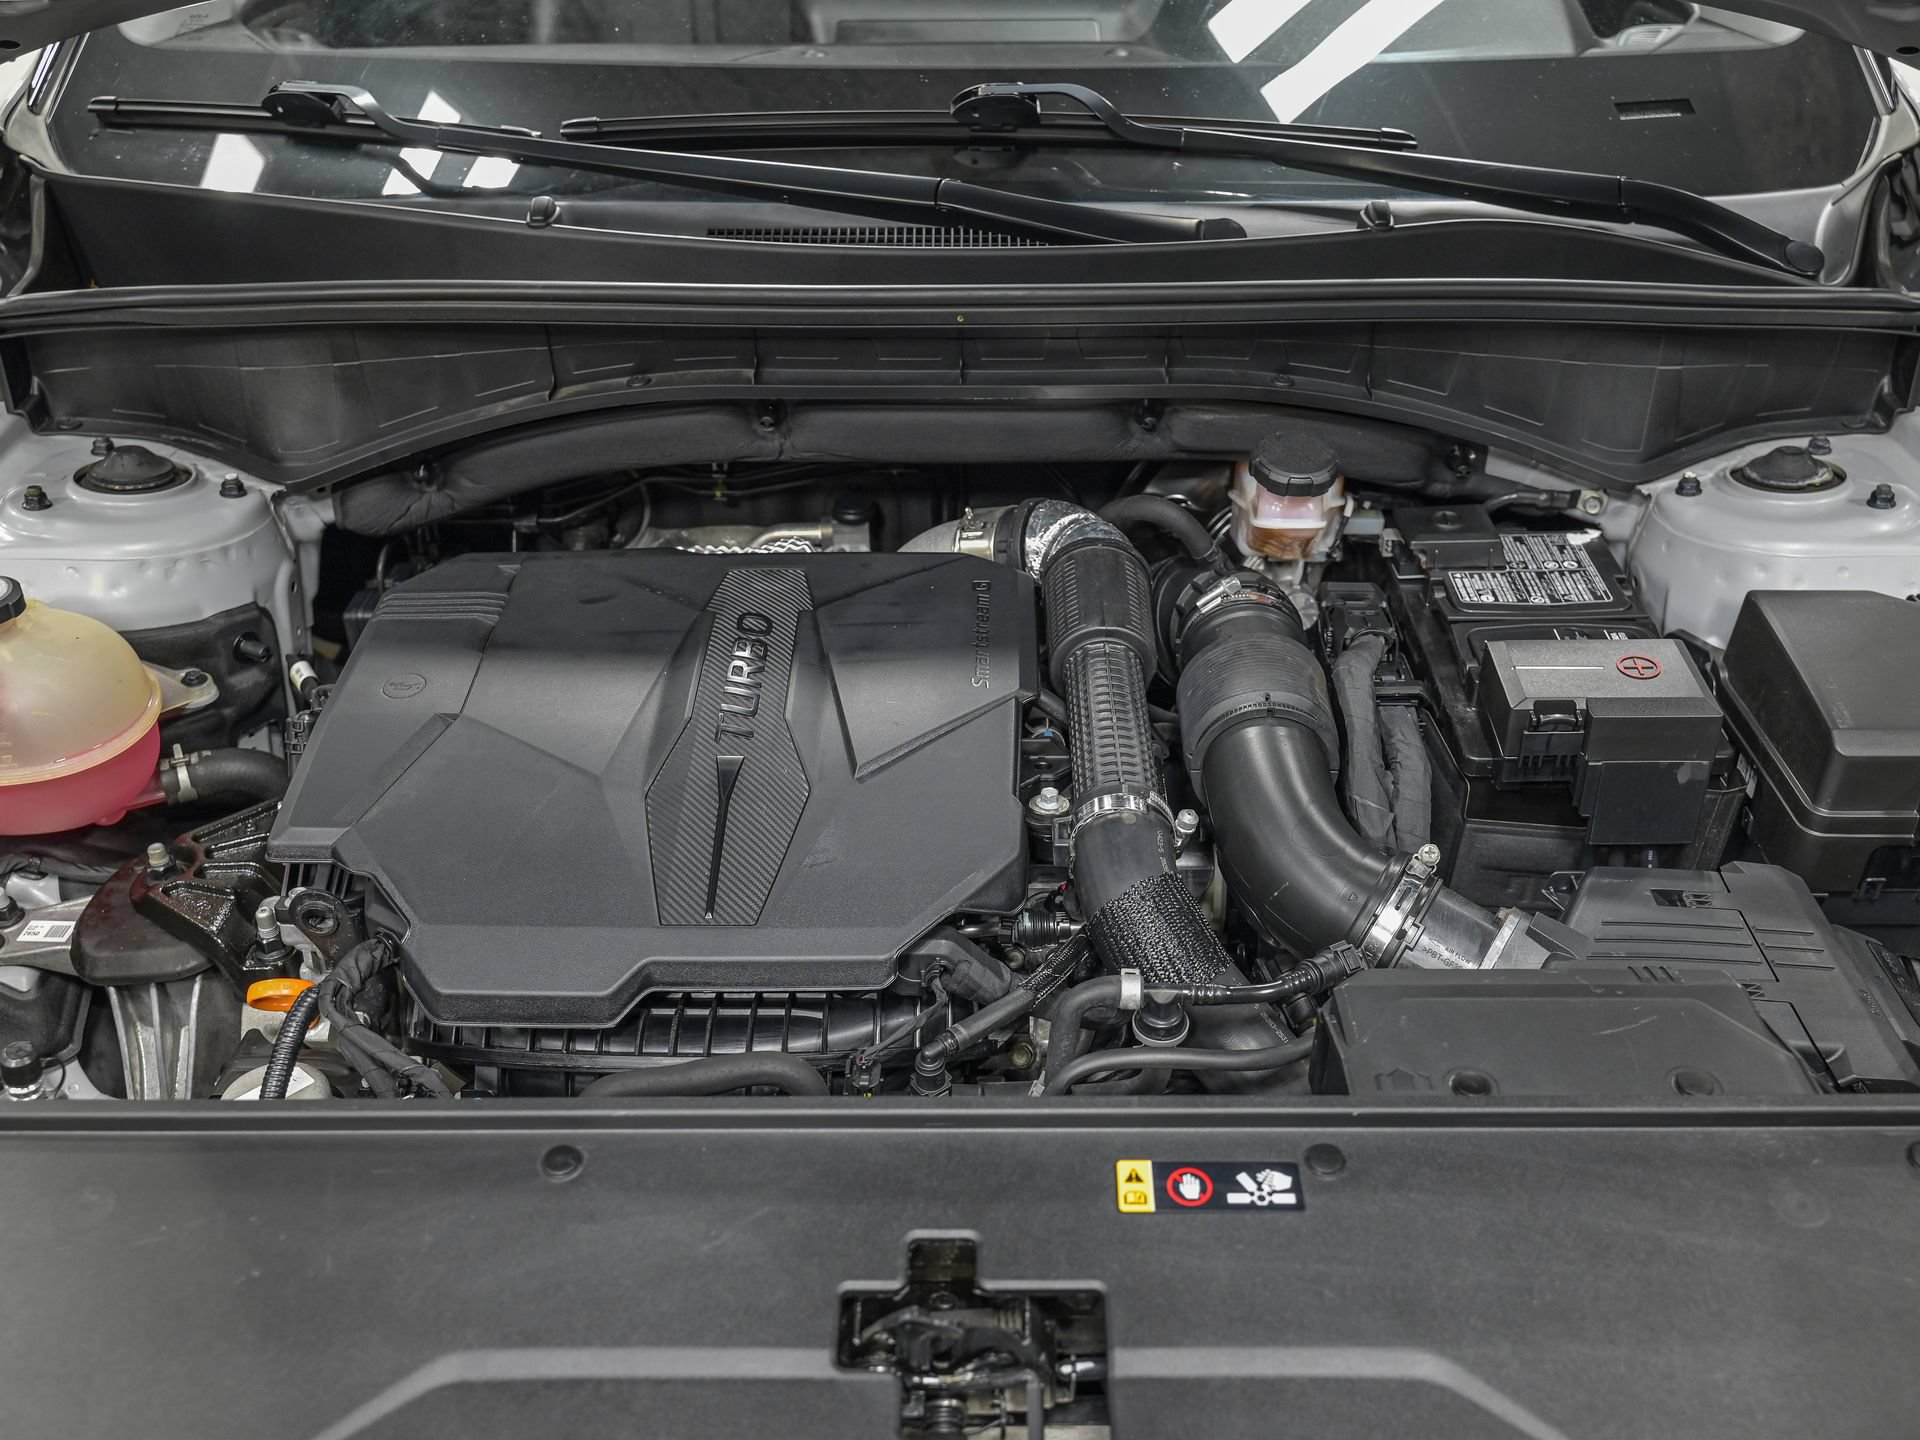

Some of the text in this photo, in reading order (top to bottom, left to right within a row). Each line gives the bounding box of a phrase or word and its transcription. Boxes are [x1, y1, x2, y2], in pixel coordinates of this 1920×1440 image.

[715, 611, 773, 743] TURBO
[971, 594, 990, 689] Smartstream
[1445, 946, 1472, 965] AIR FLOW
